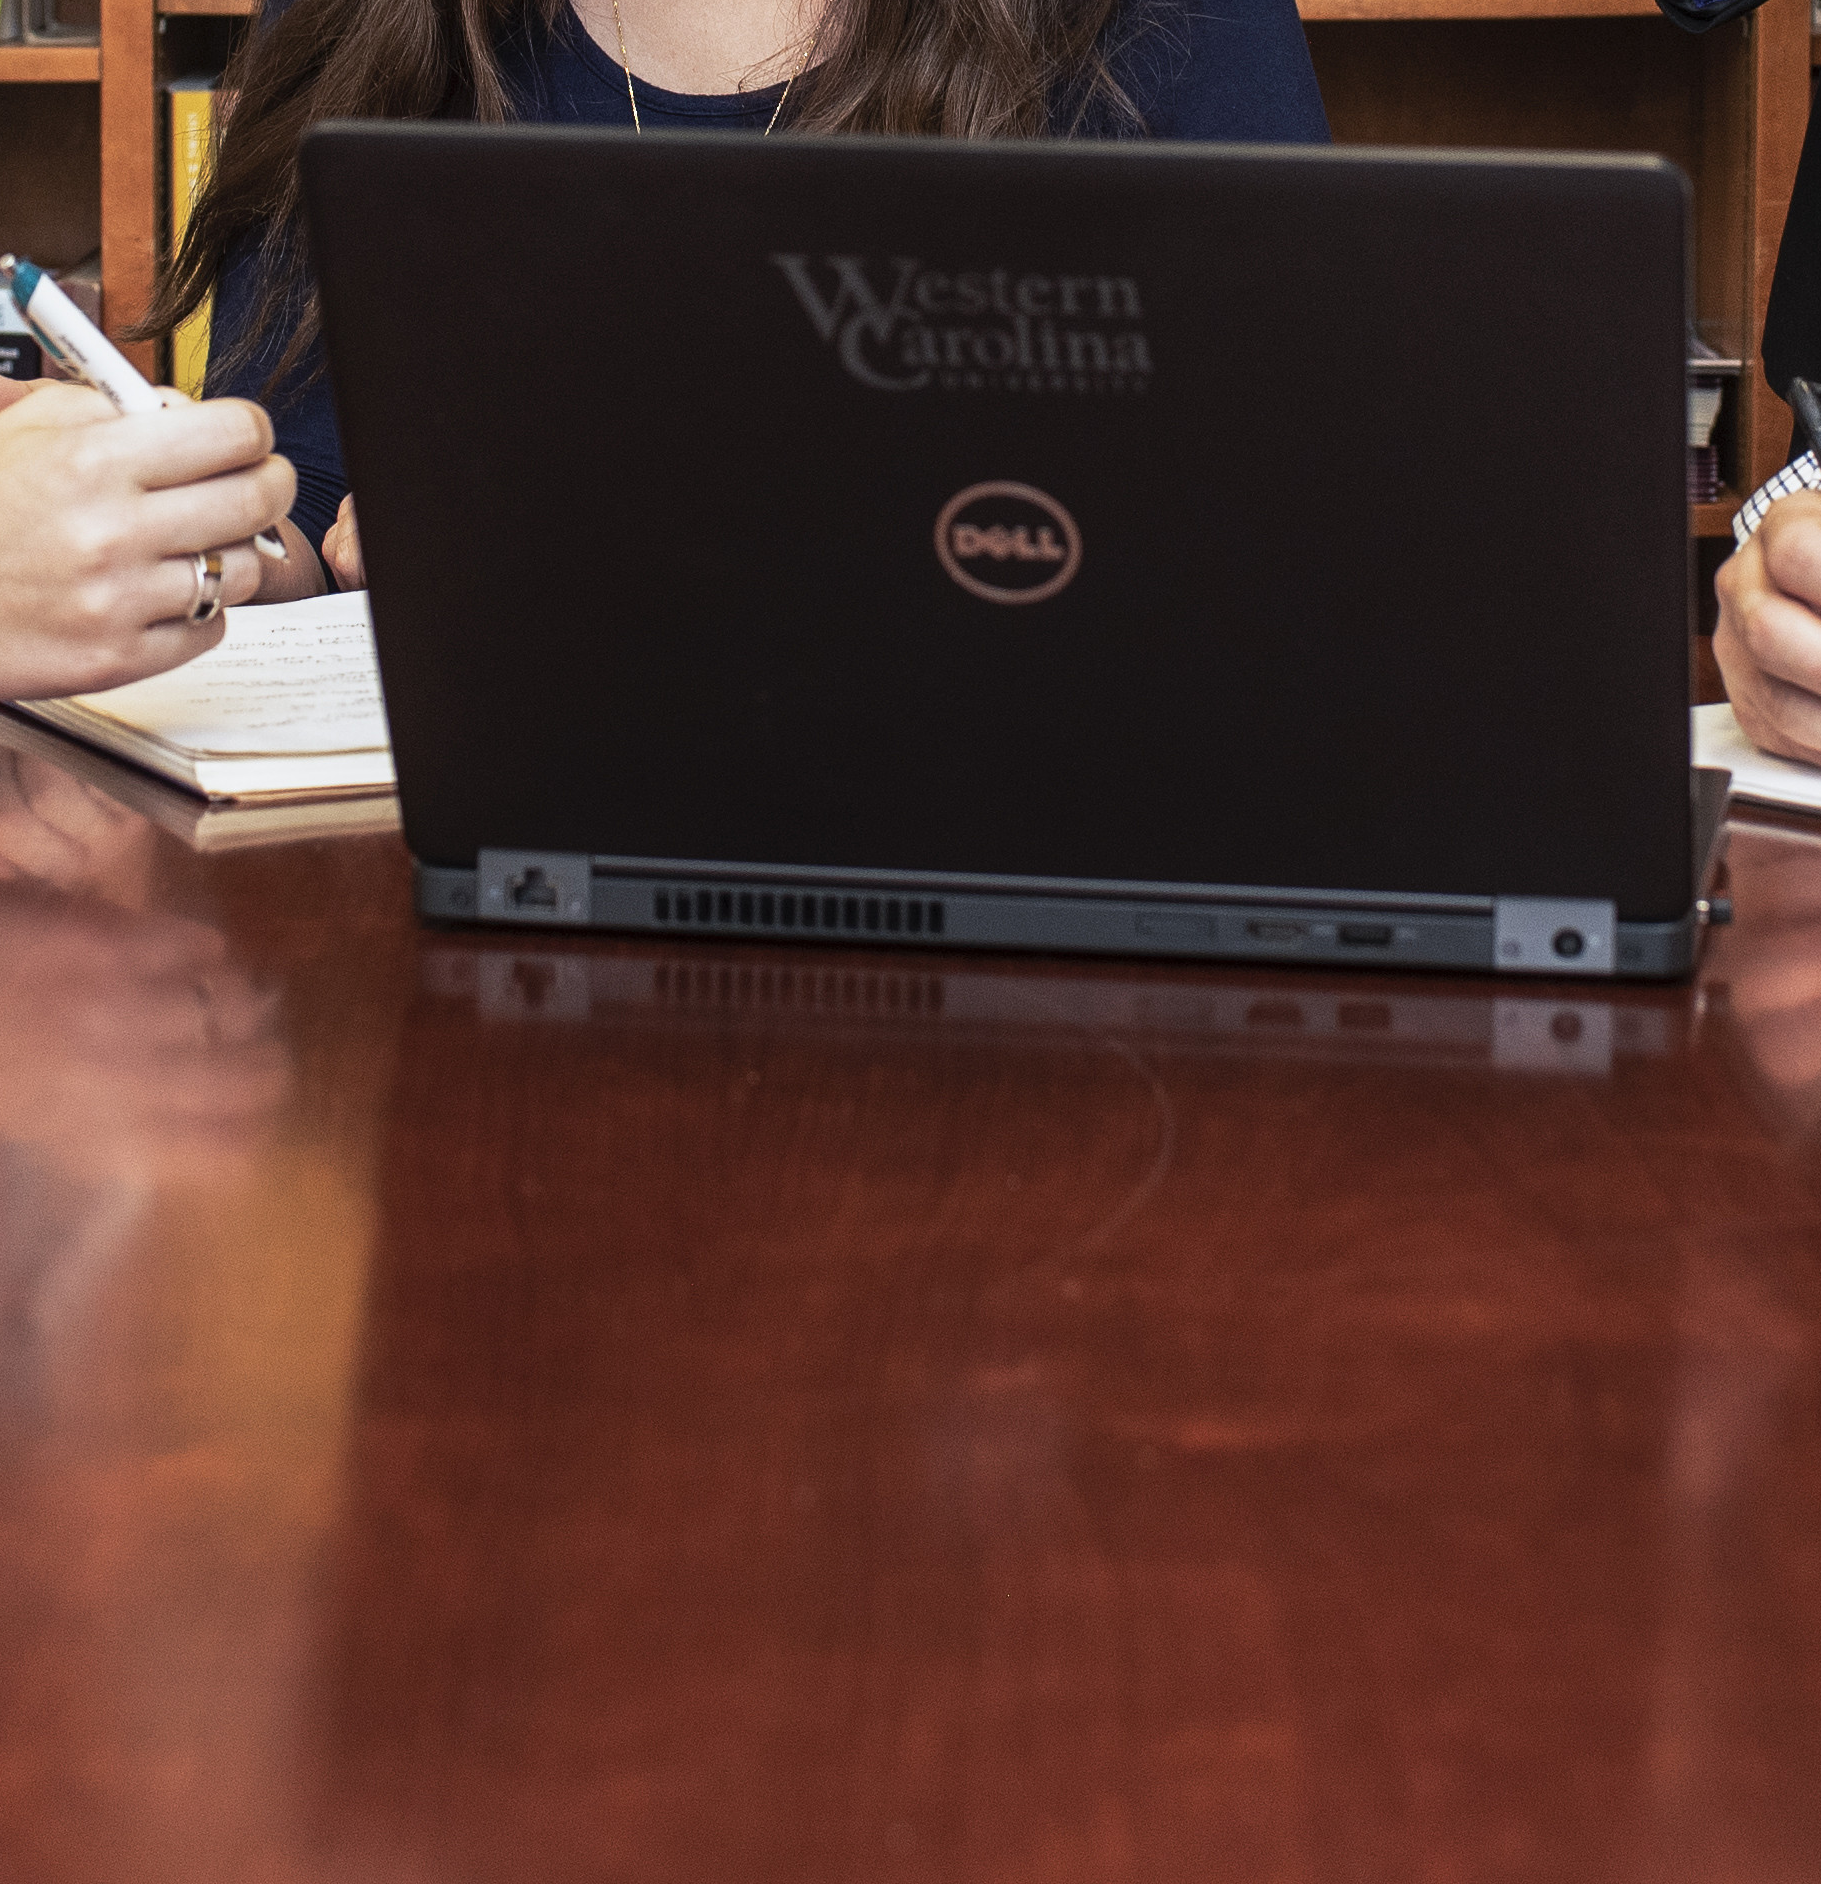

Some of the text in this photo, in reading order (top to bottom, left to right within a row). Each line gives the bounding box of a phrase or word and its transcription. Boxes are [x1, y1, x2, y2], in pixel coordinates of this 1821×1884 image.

[770, 253, 1143, 340] Western
[839, 317, 1153, 389] Carolina
[952, 524, 1064, 561] DELL
